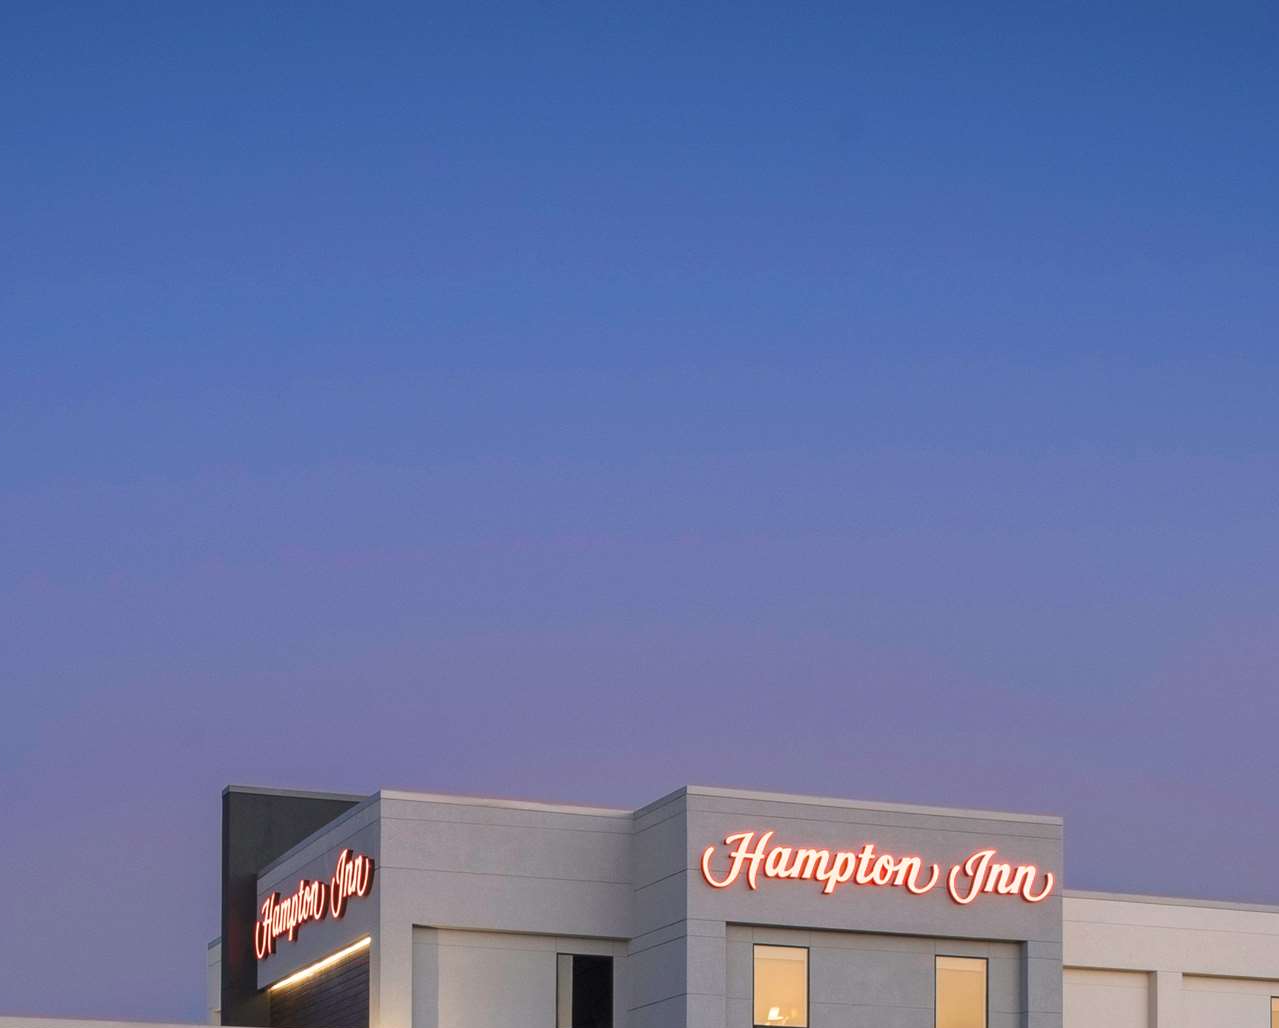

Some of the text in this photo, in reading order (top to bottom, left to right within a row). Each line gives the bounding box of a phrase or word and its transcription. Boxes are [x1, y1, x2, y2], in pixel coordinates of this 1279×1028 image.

[255, 848, 371, 960] Hampton Inn
[701, 831, 1054, 905] Hampton Inn
